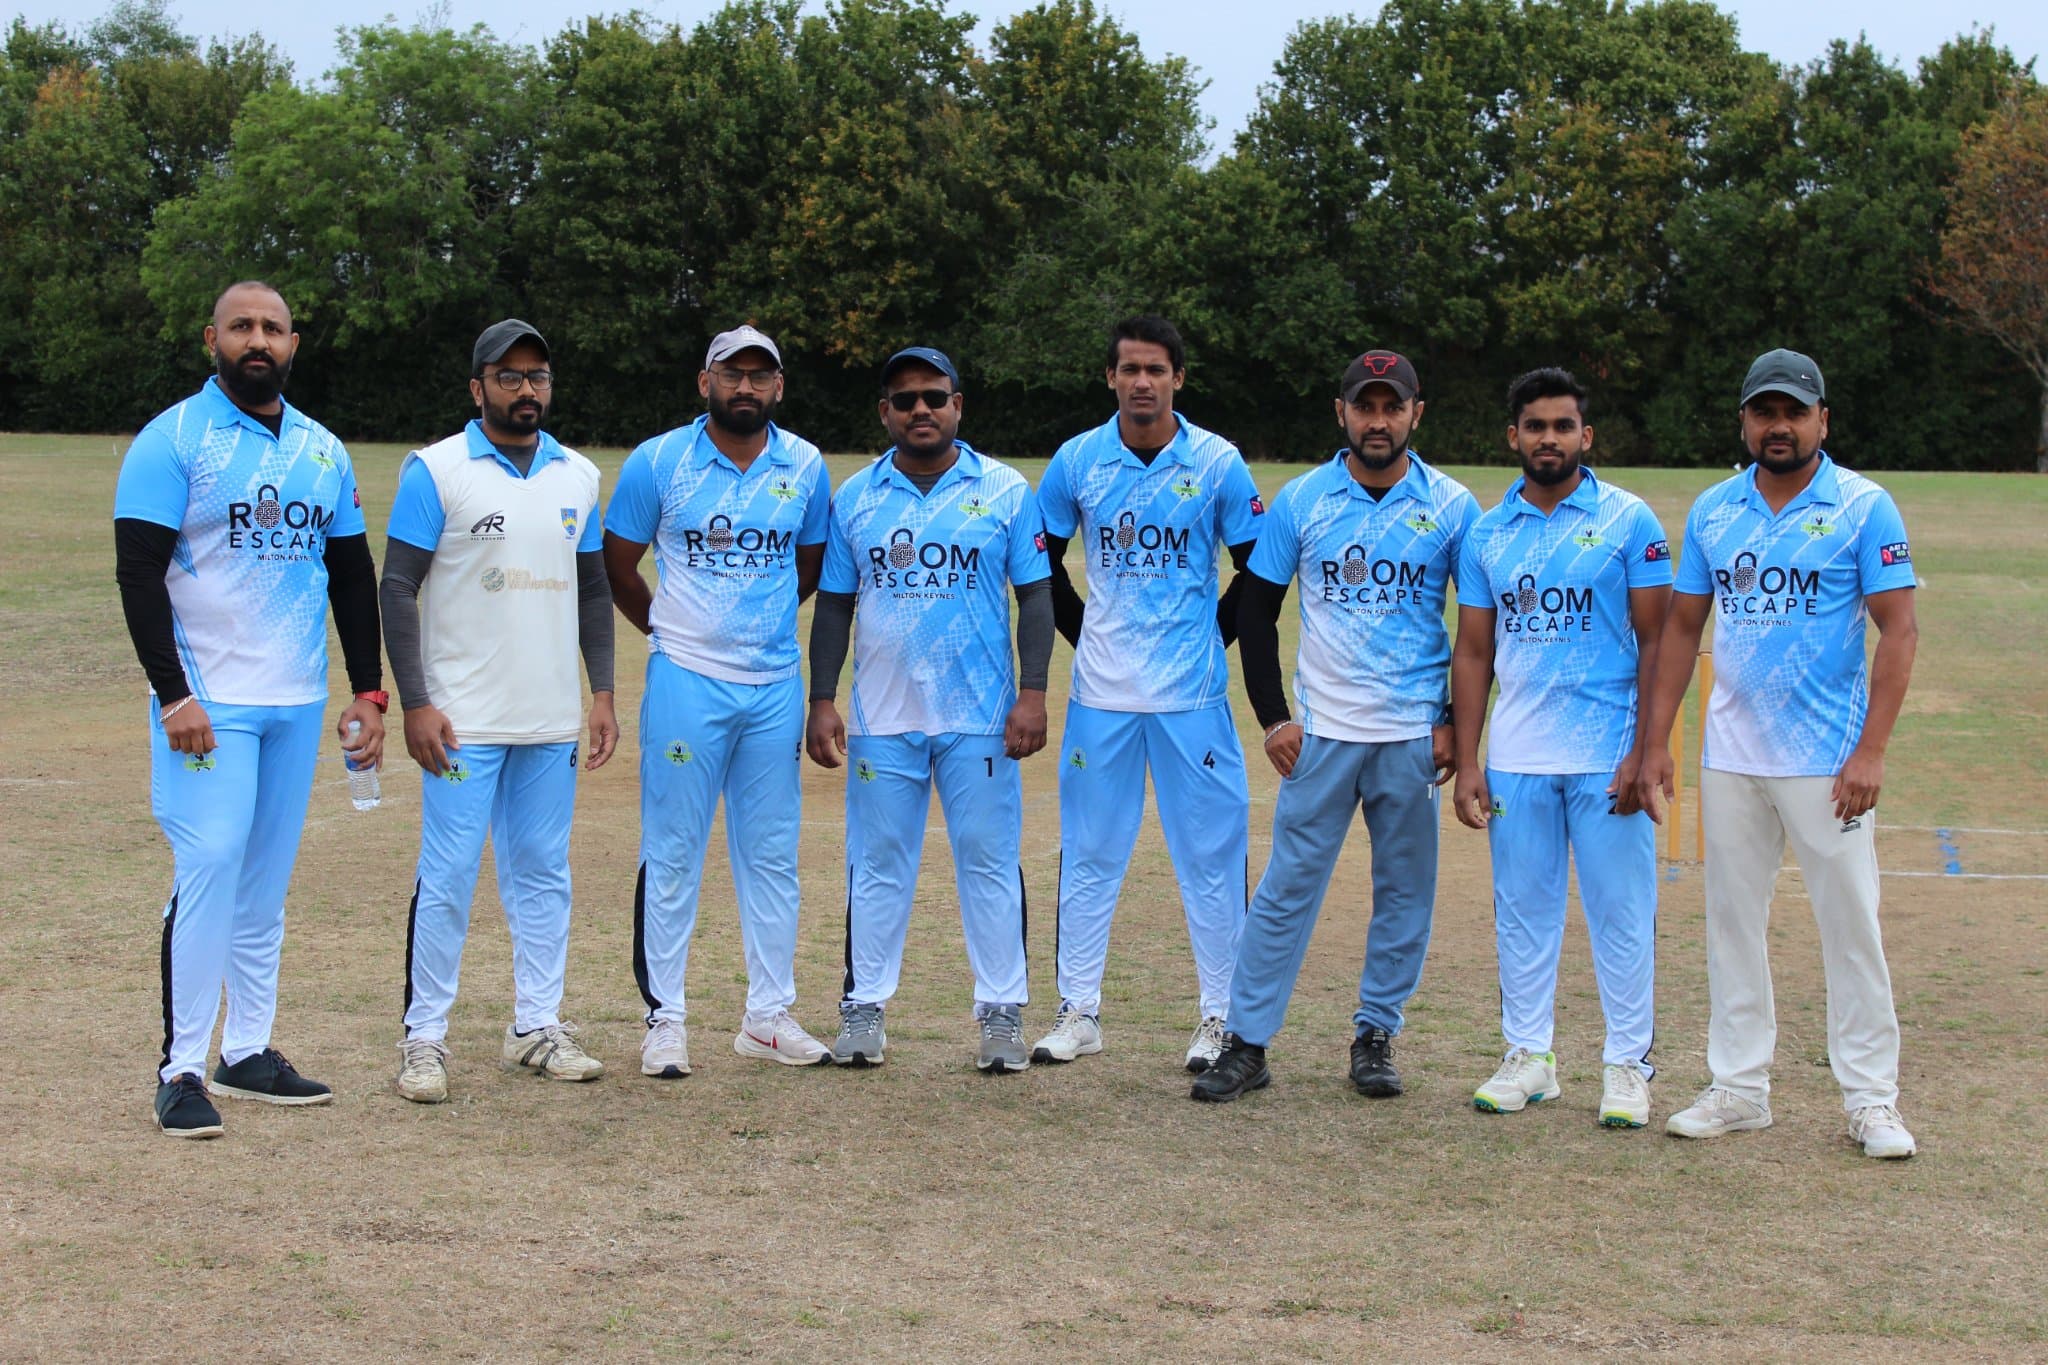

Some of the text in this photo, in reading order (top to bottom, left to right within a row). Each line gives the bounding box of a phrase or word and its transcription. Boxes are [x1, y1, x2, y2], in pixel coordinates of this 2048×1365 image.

[257, 553, 286, 561] MILTON
[687, 552, 785, 569] ESCAPE
[873, 570, 977, 589] ESCAPE
[923, 592, 955, 600] KEYNES
[1323, 586, 1423, 605] ESCAPE
[1344, 607, 1372, 615] MILTON
[1720, 596, 1818, 616] ESCAPE
[1504, 614, 1591, 633] ESCAPE
[1733, 618, 1792, 627] MILTON KEYNES
[984, 757, 993, 777] 1
[1203, 750, 1215, 769] 4
